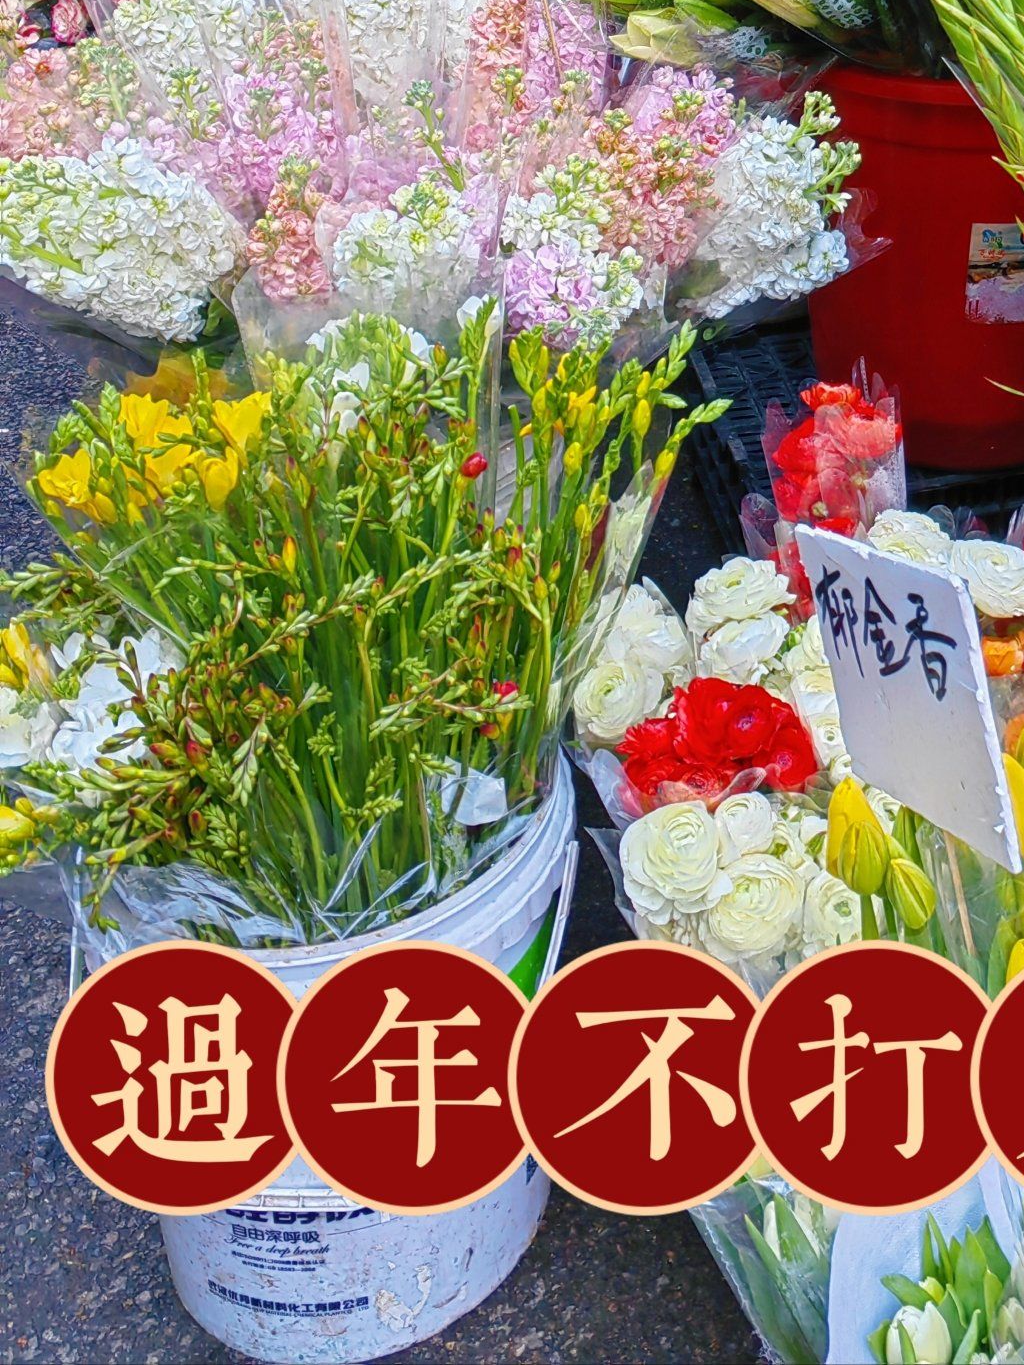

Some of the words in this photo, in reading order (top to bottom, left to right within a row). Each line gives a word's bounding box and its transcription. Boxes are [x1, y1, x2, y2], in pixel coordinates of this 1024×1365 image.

[814, 564, 958, 702] 郁金香
[231, 1223, 321, 1244] 自由深呼吸
[265, 1244, 292, 1258] deep
[292, 1242, 330, 1258] breath
